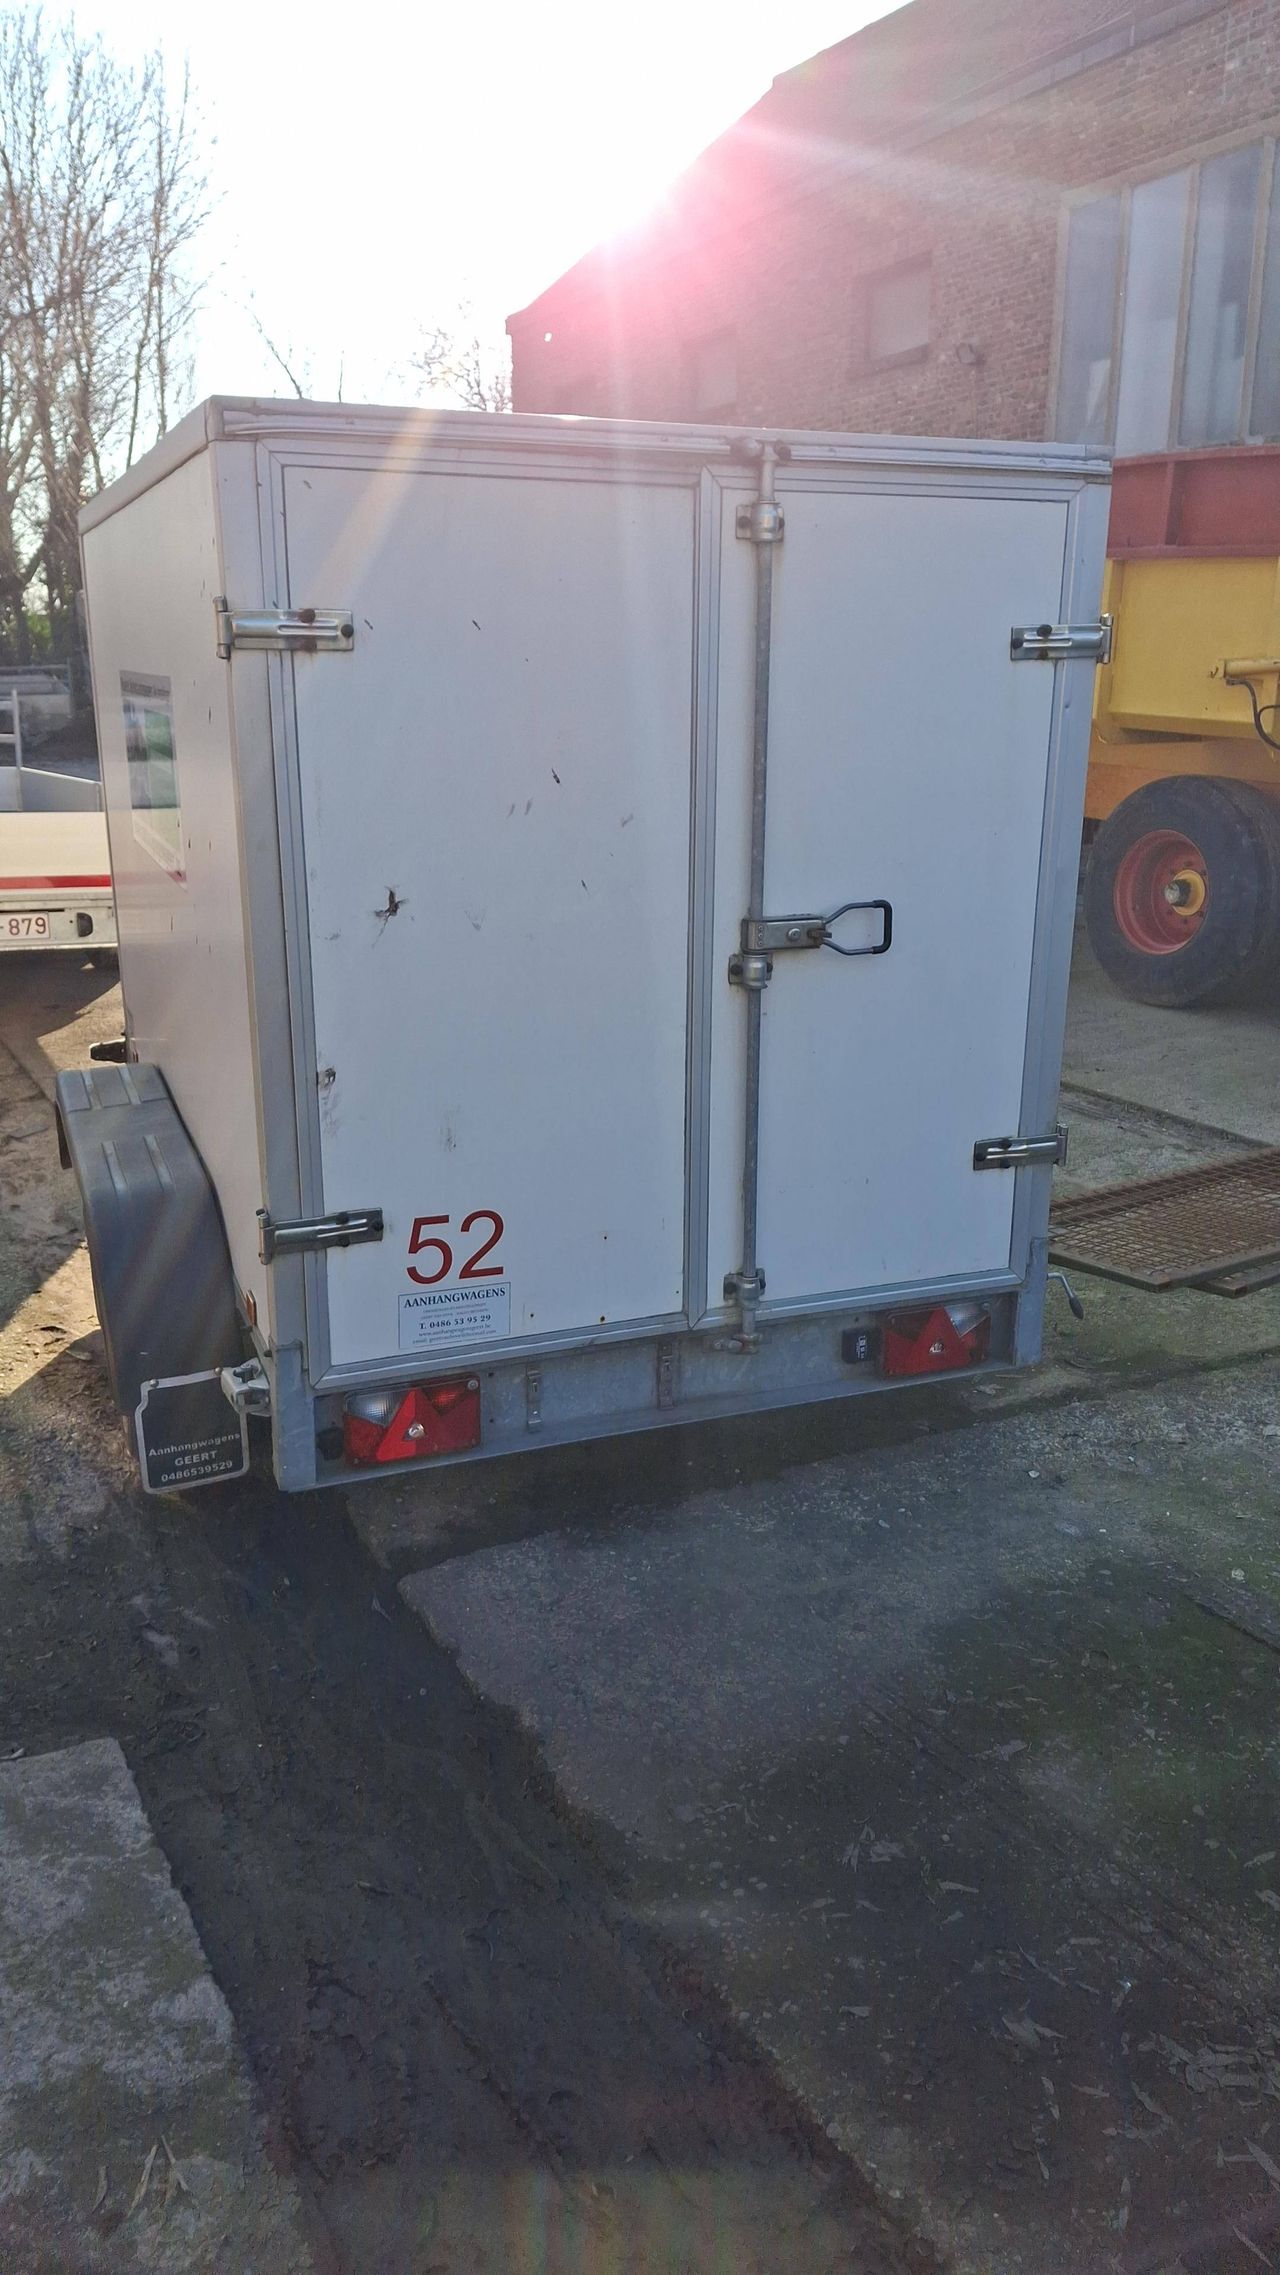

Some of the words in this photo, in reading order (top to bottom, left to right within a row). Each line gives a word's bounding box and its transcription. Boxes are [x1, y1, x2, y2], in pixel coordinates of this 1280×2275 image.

[406, 1209, 504, 1285] 52
[403, 1287, 506, 1308] AANHANGWAGENS
[429, 1318, 452, 1329] 0486
[454, 1316, 464, 1325] 53
[467, 1314, 478, 1323] 95
[480, 1313, 491, 1322] 29
[148, 1432, 240, 1457] Aanhangwagens
[174, 1450, 218, 1466] GEERT
[161, 1460, 233, 1482] 0486539529
